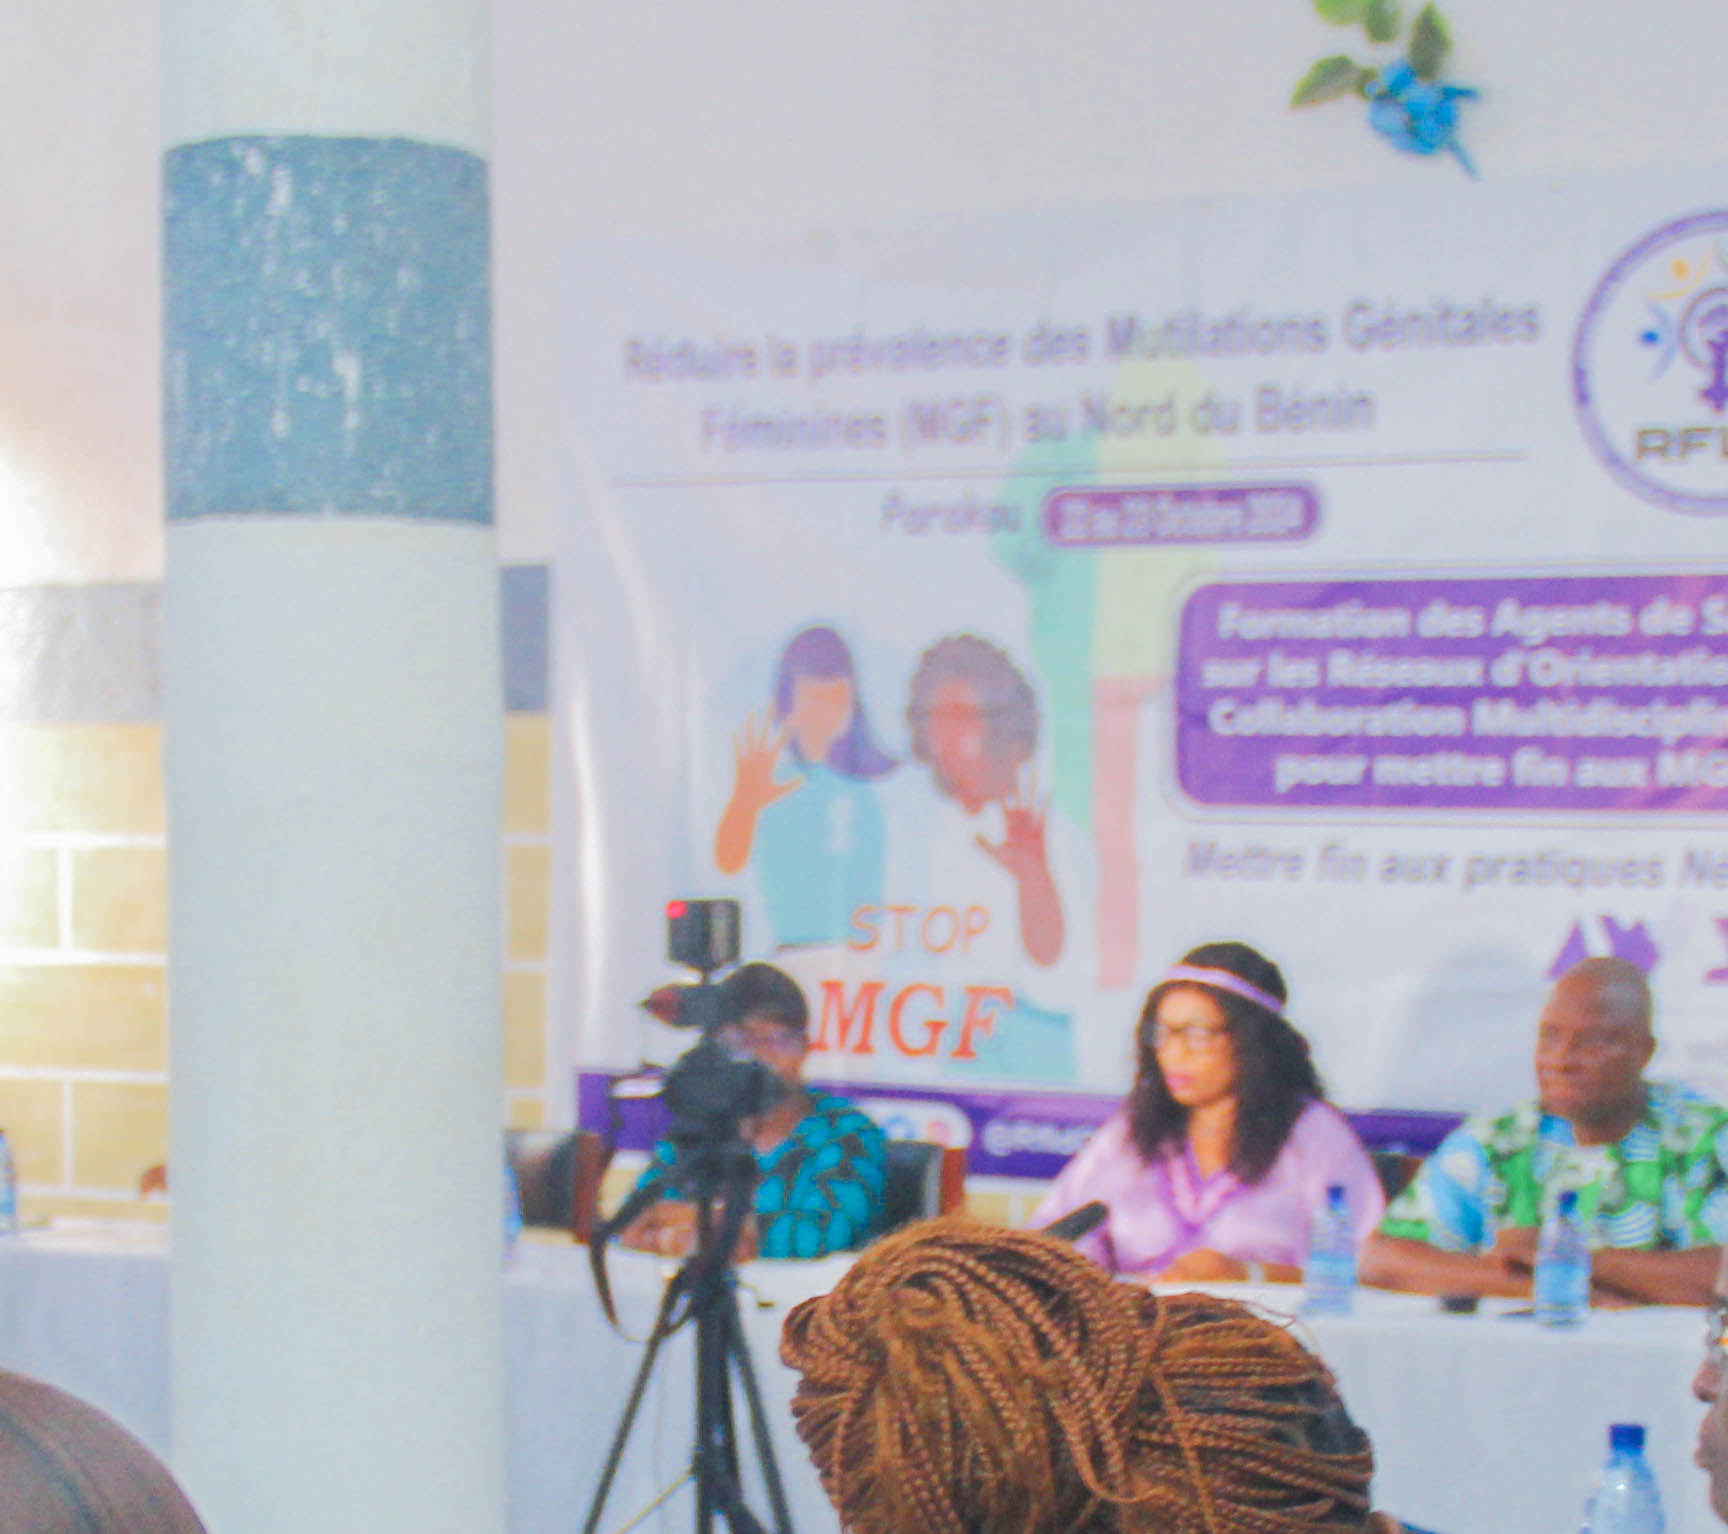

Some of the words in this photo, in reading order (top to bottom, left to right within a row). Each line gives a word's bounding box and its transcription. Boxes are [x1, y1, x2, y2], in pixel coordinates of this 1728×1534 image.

[624, 335, 759, 381] Réduire
[768, 334, 798, 379] la
[809, 326, 1011, 383] prévalence
[1024, 319, 1091, 365] des
[1106, 306, 1329, 358] Mutilations
[1343, 297, 1542, 351] Génitales
[700, 406, 887, 453] Féminines
[900, 396, 1011, 457] (MGF)
[1024, 408, 1068, 442] au
[1083, 393, 1178, 437] Nord
[1188, 389, 1240, 435] du
[1254, 384, 1374, 434] Bénin
[1218, 600, 1411, 640] Formation
[1416, 599, 1485, 638] des
[1490, 597, 1631, 646] Agents
[1638, 595, 1694, 637] de
[1202, 657, 1262, 688] sur
[1268, 649, 1320, 688] les
[1327, 647, 1484, 688] Réseaux
[1207, 698, 1466, 738] Collaboration
[1275, 754, 1368, 794] pour
[1373, 751, 1506, 787] mettre
[1513, 746, 1569, 787] fin
[1574, 755, 1649, 788] aux
[1184, 840, 1306, 882] Mettre
[1318, 842, 1366, 882] fin
[1380, 851, 1454, 884] aux
[1463, 846, 1666, 893] pratiques
[846, 904, 991, 954] STOP
[807, 979, 1016, 1059] MGF
